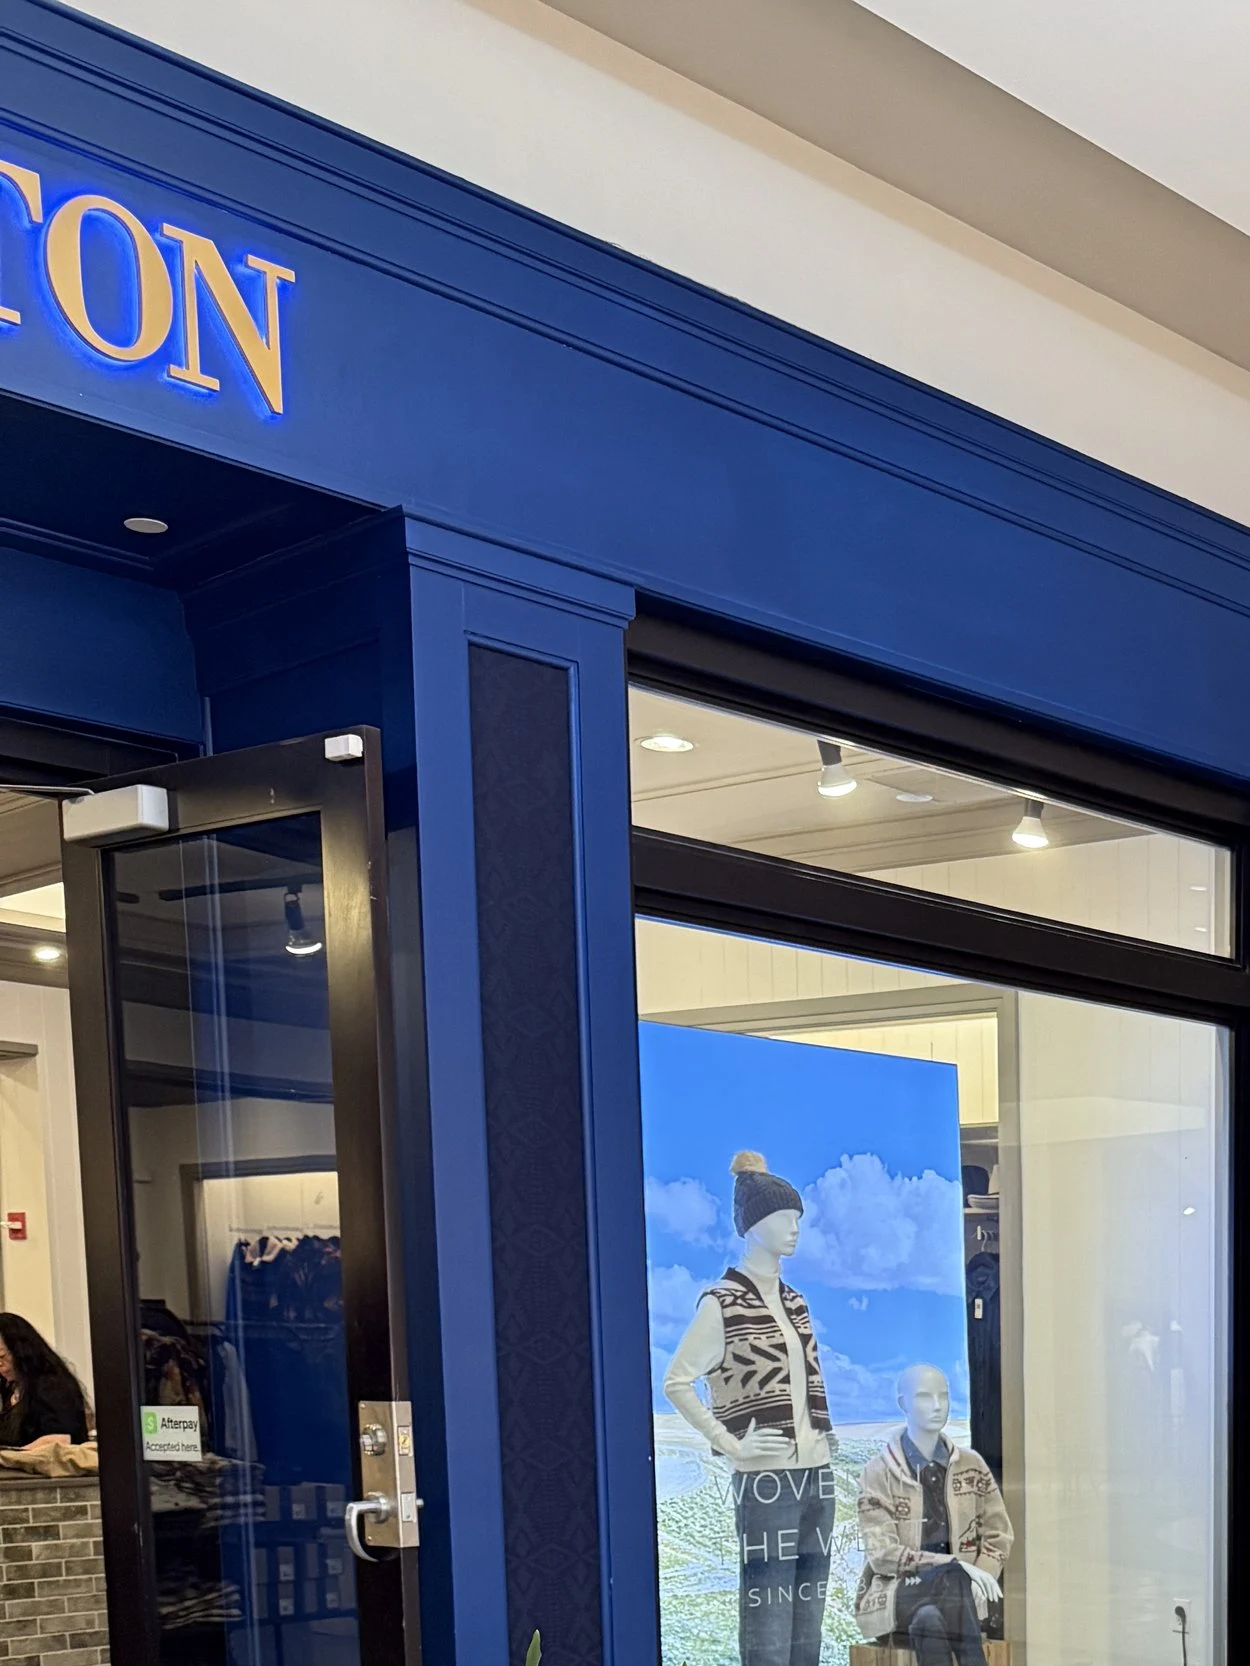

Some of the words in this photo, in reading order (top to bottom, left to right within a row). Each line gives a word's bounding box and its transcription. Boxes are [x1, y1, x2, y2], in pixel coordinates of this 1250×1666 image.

[160, 1417, 198, 1432] Afterpay
[145, 1441, 181, 1453] Accepted
[712, 1529, 799, 1566] THE
[748, 1581, 827, 1608] SINCE
